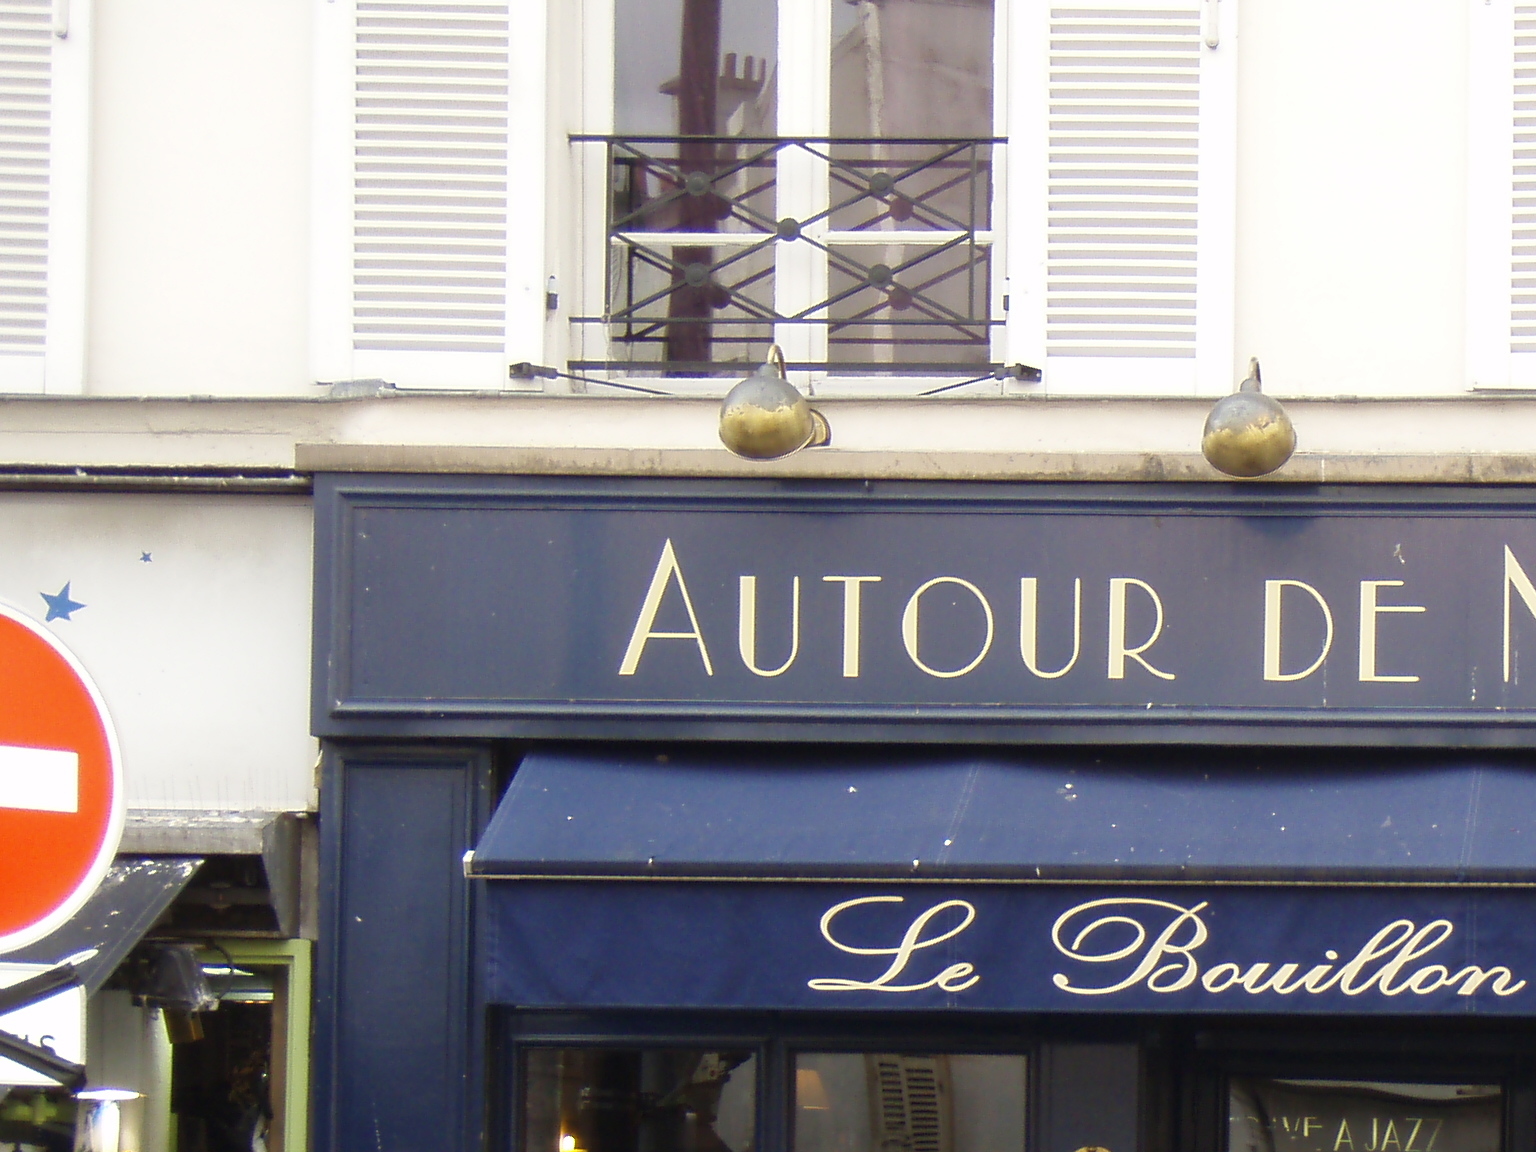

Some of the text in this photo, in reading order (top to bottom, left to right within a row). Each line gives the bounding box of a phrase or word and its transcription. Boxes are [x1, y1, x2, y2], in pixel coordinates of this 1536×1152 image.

[618, 538, 1175, 681] AUTOUR
[1264, 578, 1427, 684] DE
[808, 895, 981, 993] Le
[1050, 897, 1528, 998] Bouillon
